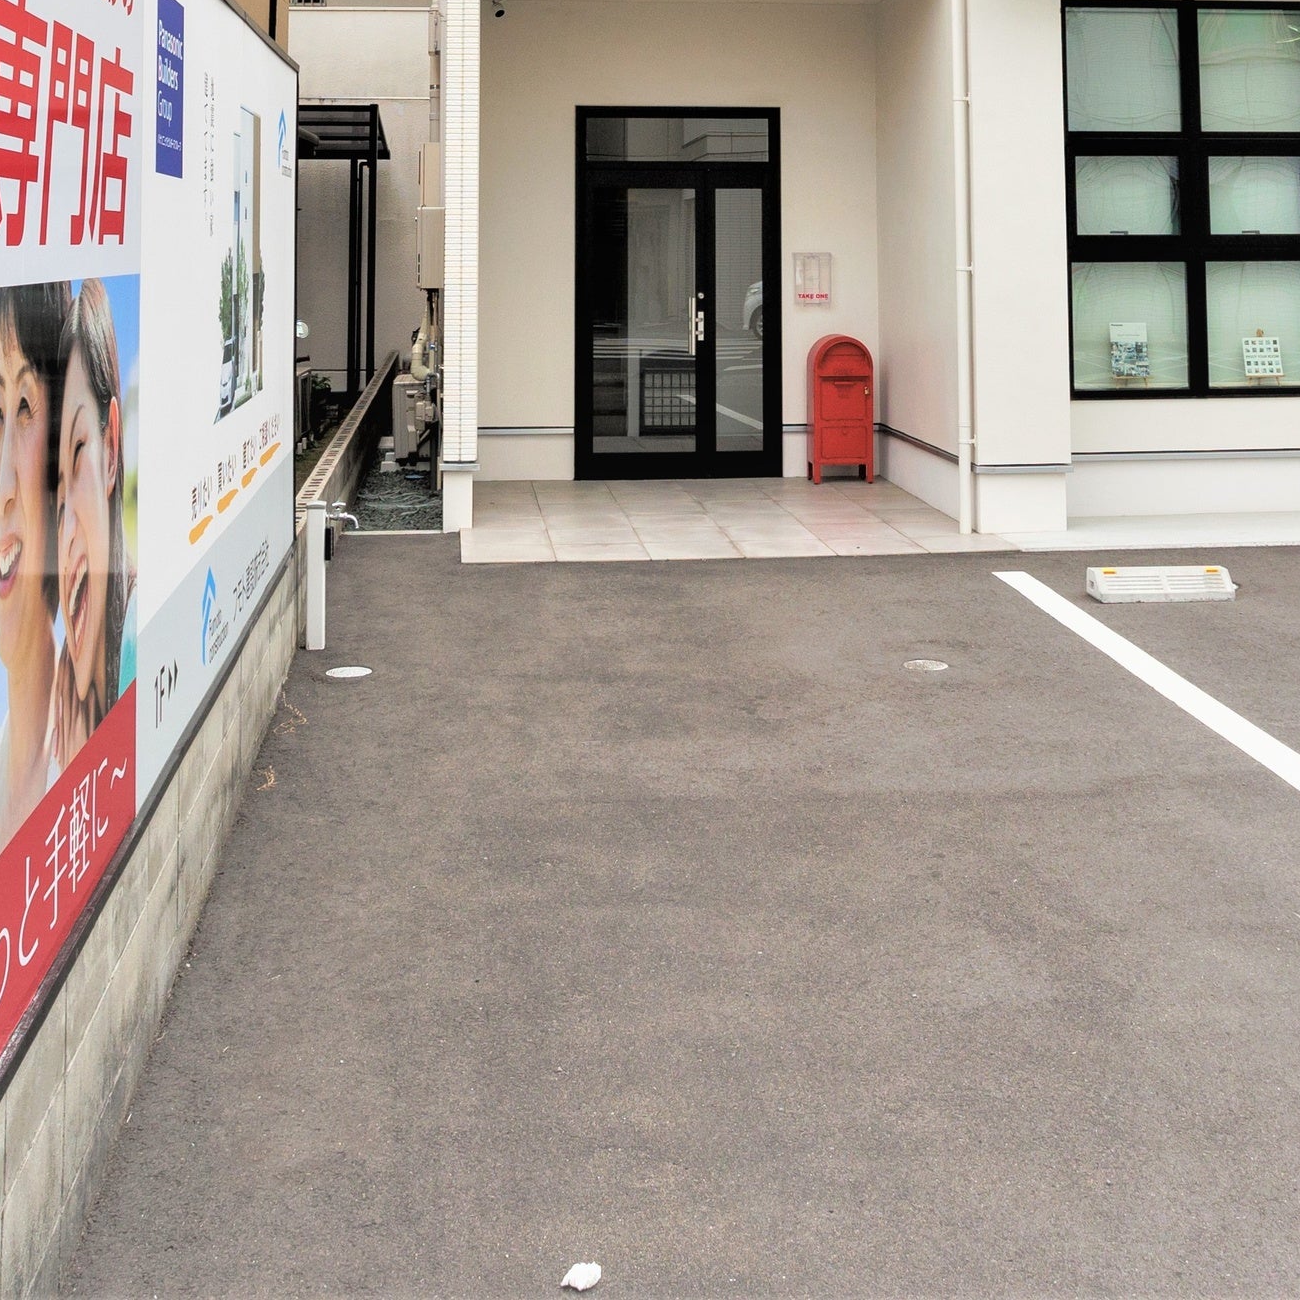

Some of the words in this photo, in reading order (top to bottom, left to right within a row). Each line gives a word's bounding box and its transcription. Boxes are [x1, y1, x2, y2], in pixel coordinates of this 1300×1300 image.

[158, 19, 184, 61] Panasonic
[157, 54, 179, 91] Builders
[157, 90, 173, 128] Group
